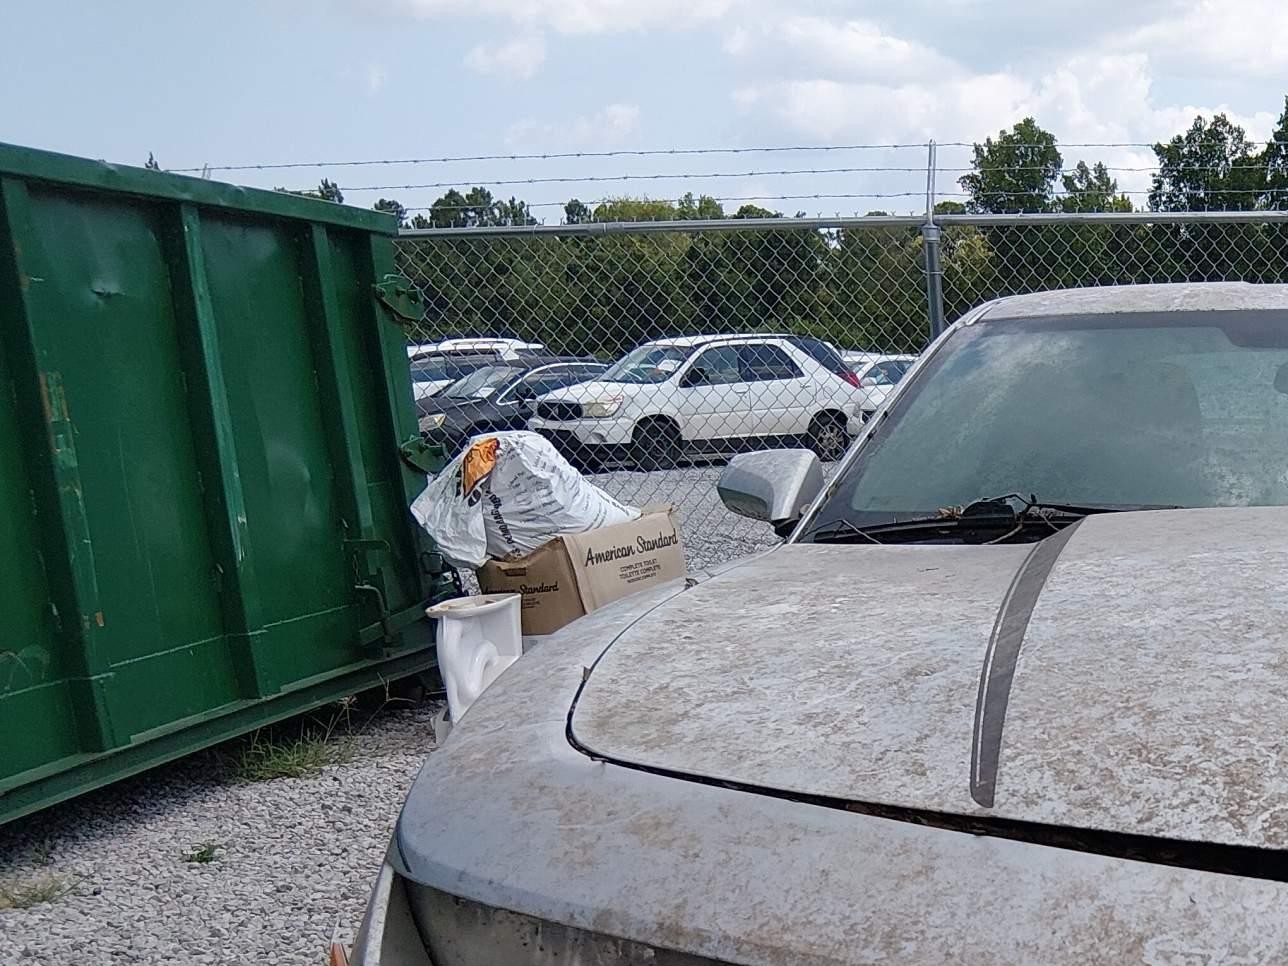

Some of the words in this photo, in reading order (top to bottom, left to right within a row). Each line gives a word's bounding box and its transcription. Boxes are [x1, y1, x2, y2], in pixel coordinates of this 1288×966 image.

[584, 545, 636, 568] American
[635, 527, 679, 554] Standard
[519, 580, 559, 596] Standard
